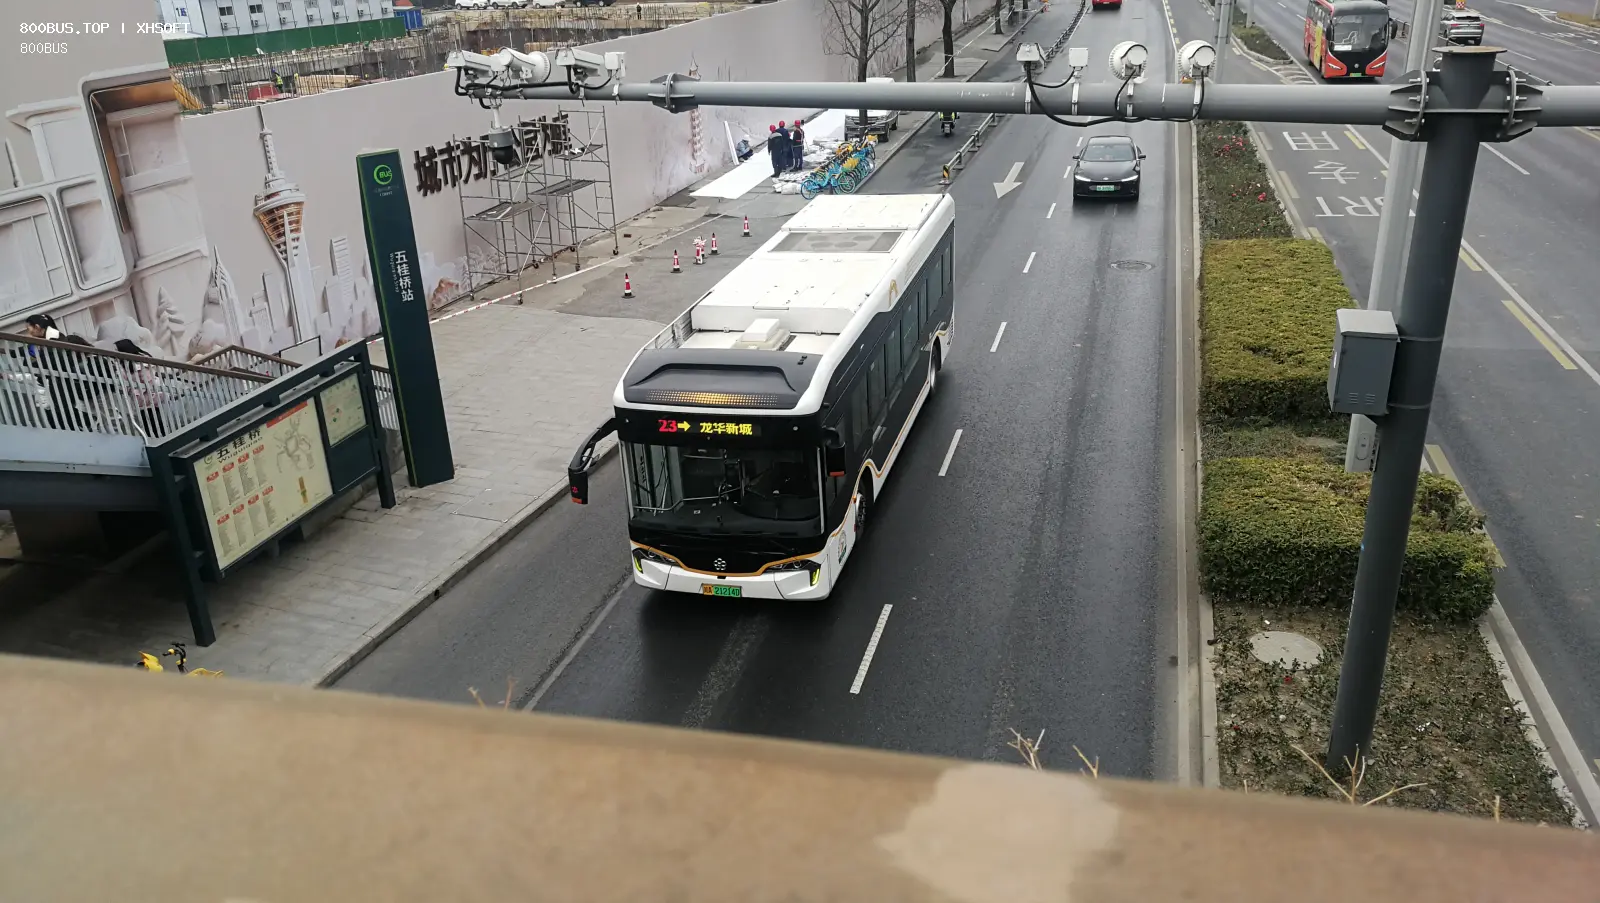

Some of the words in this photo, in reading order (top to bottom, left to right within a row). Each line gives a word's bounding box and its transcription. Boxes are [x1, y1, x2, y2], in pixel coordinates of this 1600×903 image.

[394, 250, 414, 302] 五桂桥站
[658, 419, 678, 432] 23
[700, 422, 753, 435] 龙华新城
[216, 428, 261, 460] 五桂桥
